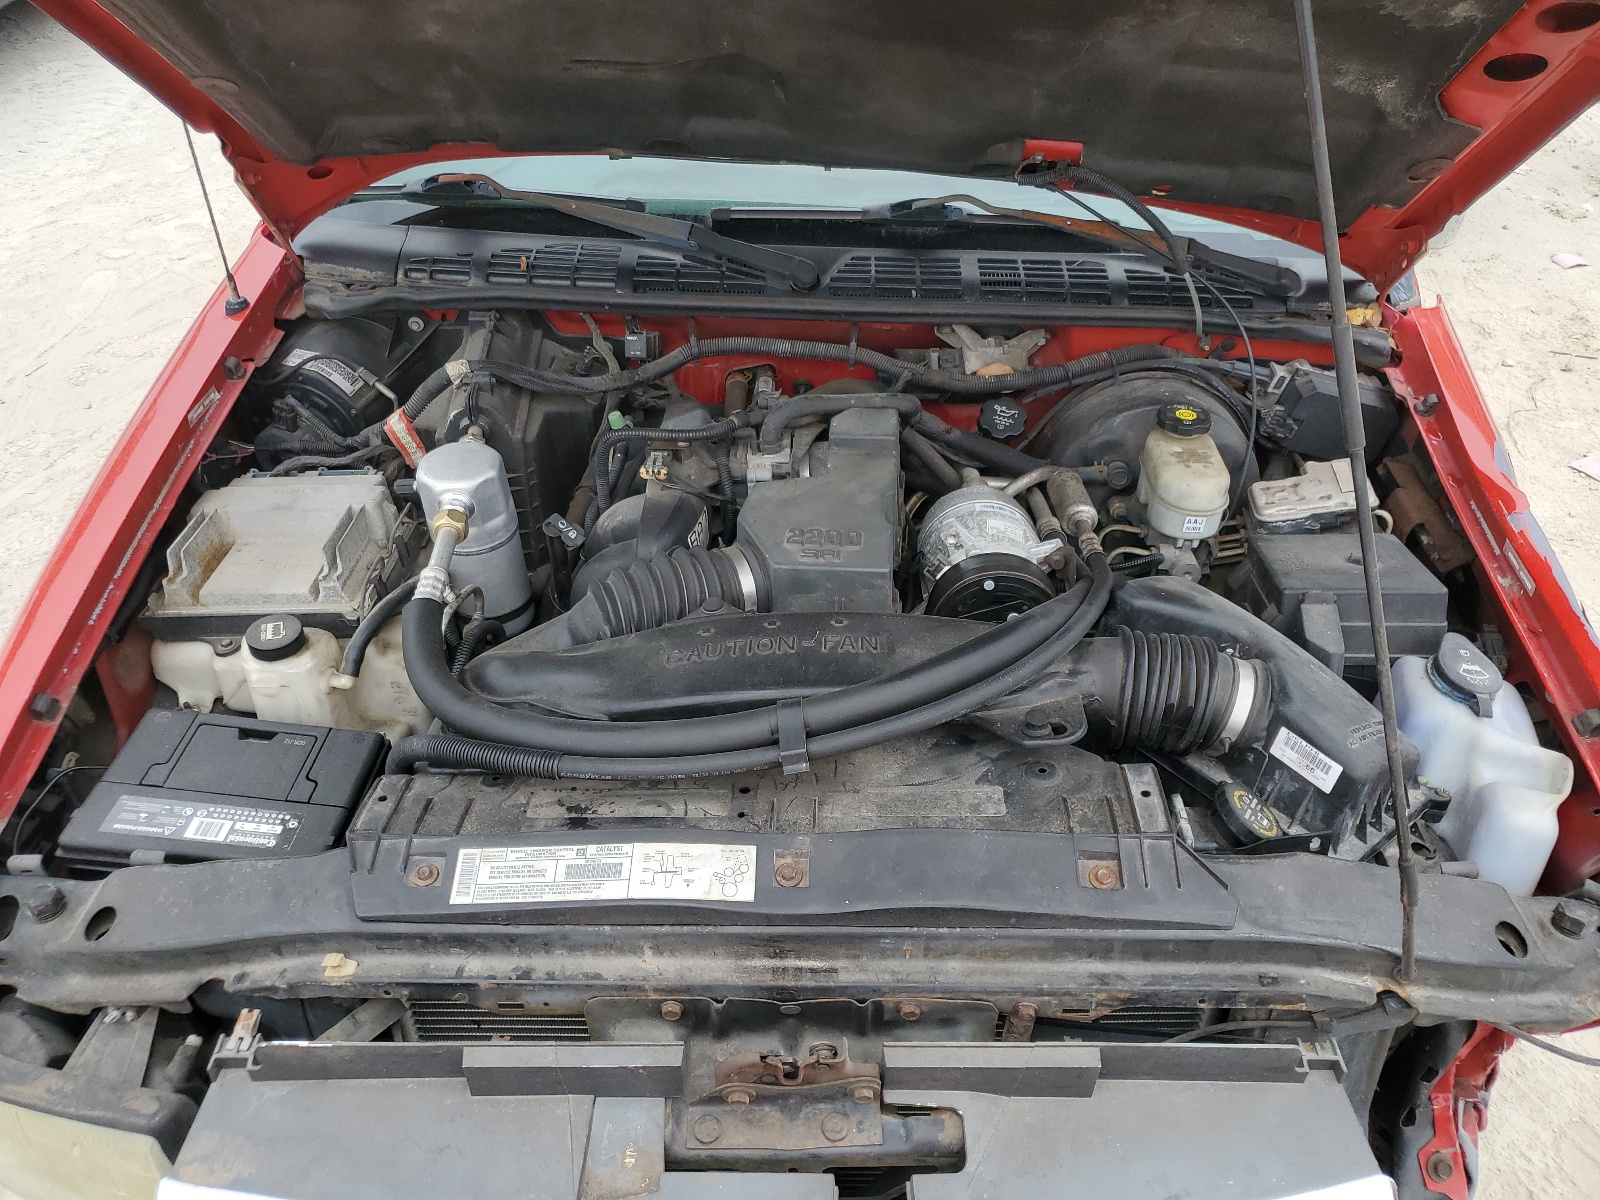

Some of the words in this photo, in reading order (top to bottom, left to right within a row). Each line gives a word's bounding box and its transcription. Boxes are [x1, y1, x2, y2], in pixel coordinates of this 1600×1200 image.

[785, 528, 863, 548] 2200
[226, 834, 276, 847] Continental
[595, 845, 624, 853] CATALYST
